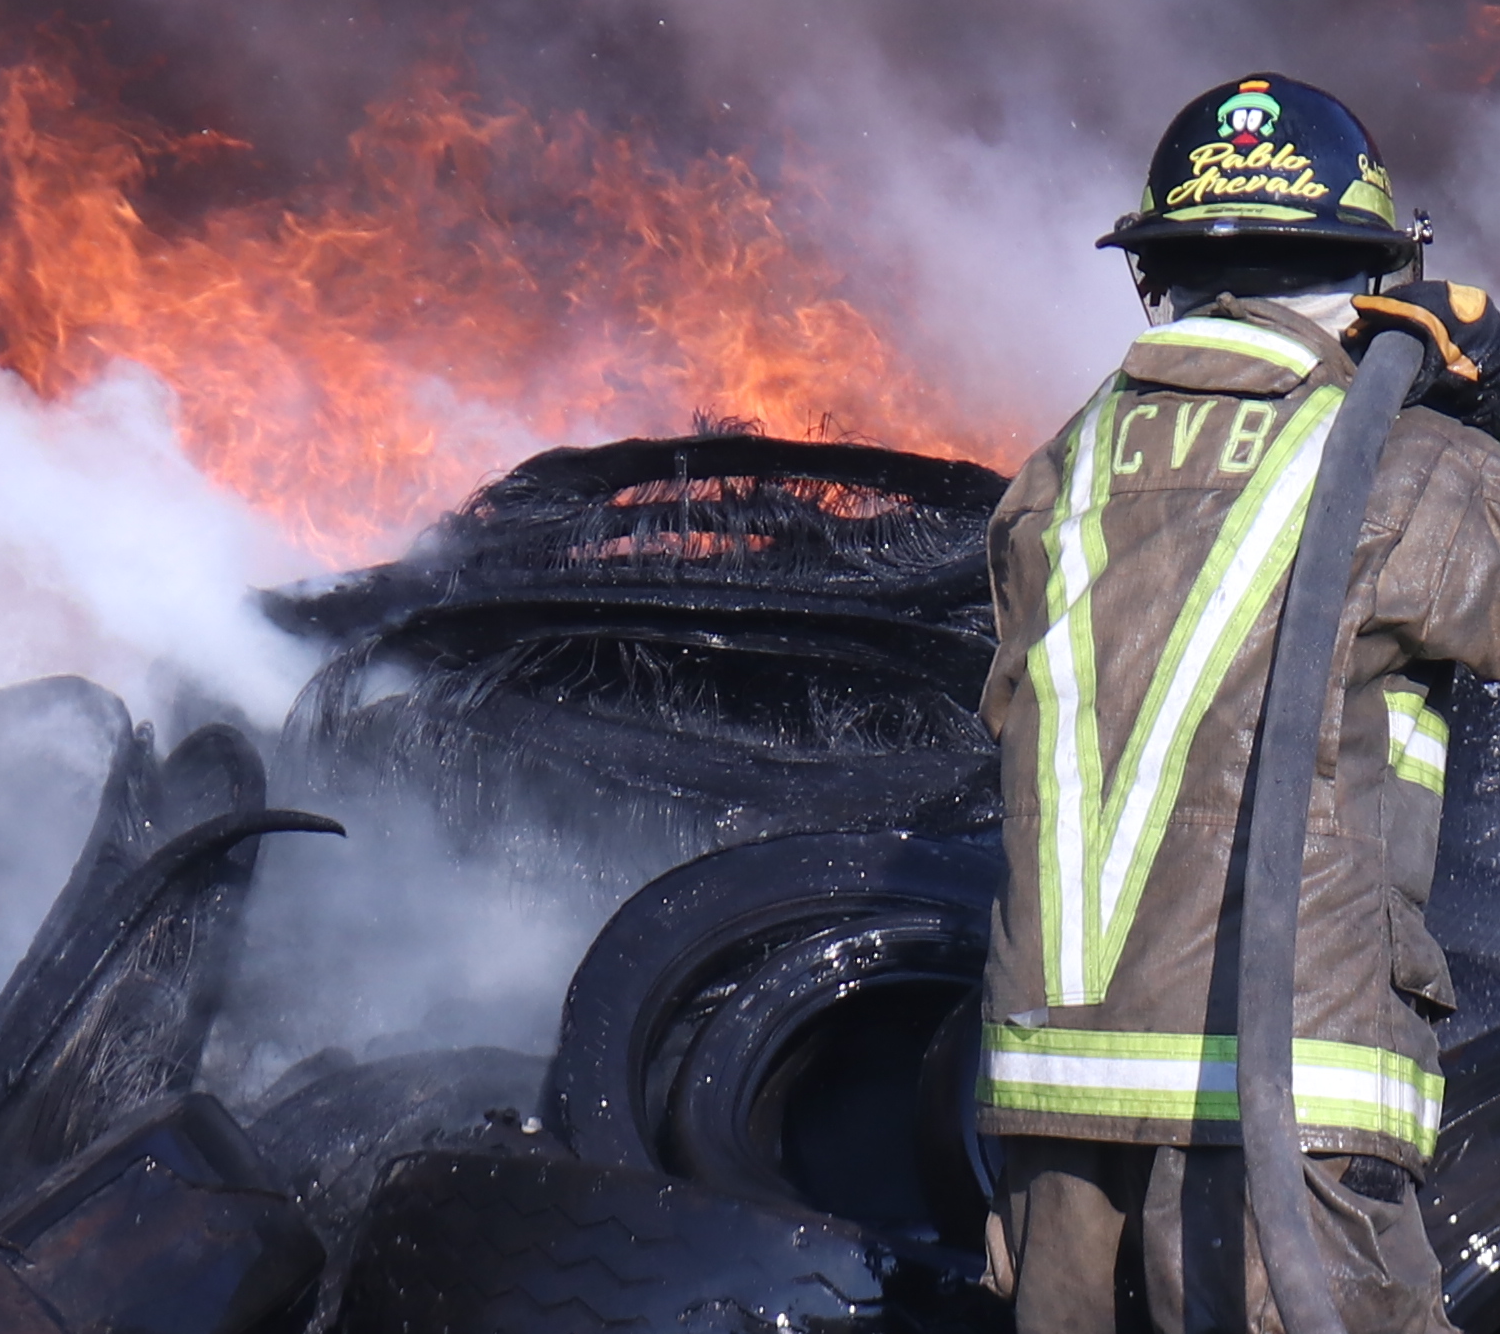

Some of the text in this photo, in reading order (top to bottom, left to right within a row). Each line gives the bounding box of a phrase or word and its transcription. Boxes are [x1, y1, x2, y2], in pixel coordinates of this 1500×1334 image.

[1189, 141, 1311, 175] Pablo
[1166, 166, 1329, 205] Arevalo
[1112, 399, 1277, 474] CVB
